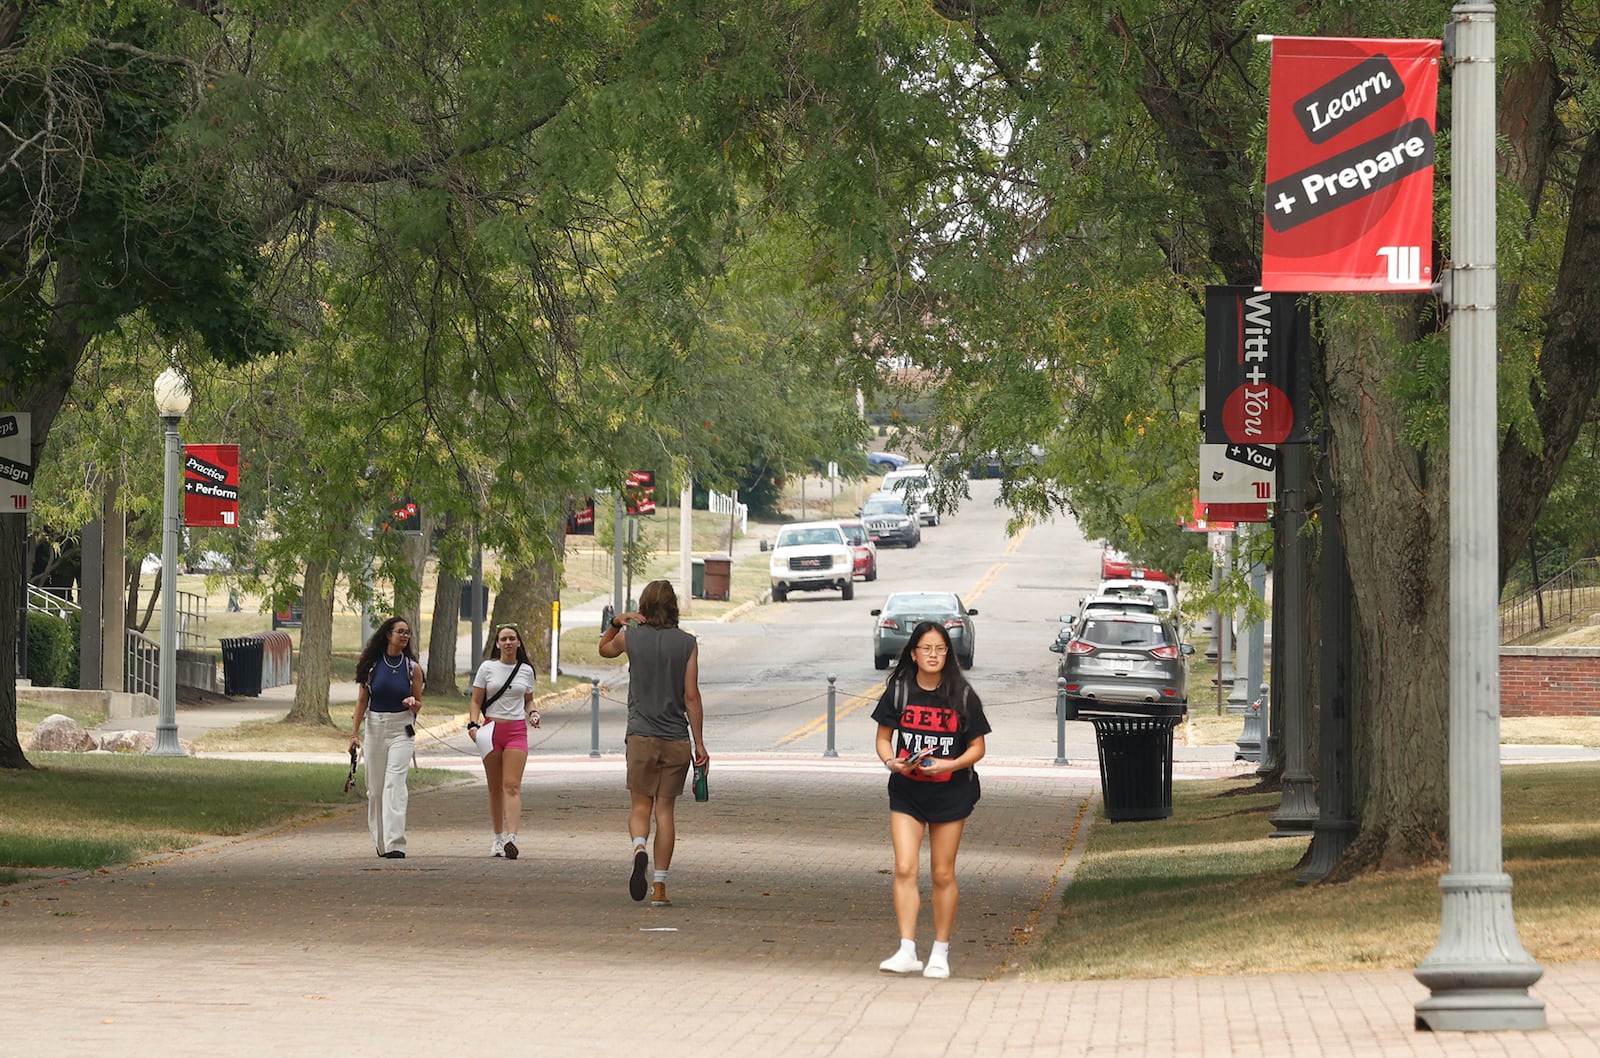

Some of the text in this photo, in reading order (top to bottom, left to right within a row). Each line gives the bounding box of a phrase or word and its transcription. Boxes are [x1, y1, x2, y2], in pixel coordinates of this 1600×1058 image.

[1306, 71, 1391, 132] Learn
[1274, 136, 1425, 214] + Prepare
[1245, 292, 1271, 436] Witt + You
[1246, 447, 1272, 467] You
[186, 458, 225, 481] Practice
[195, 483, 237, 499] Perform
[903, 709, 952, 728] GET
